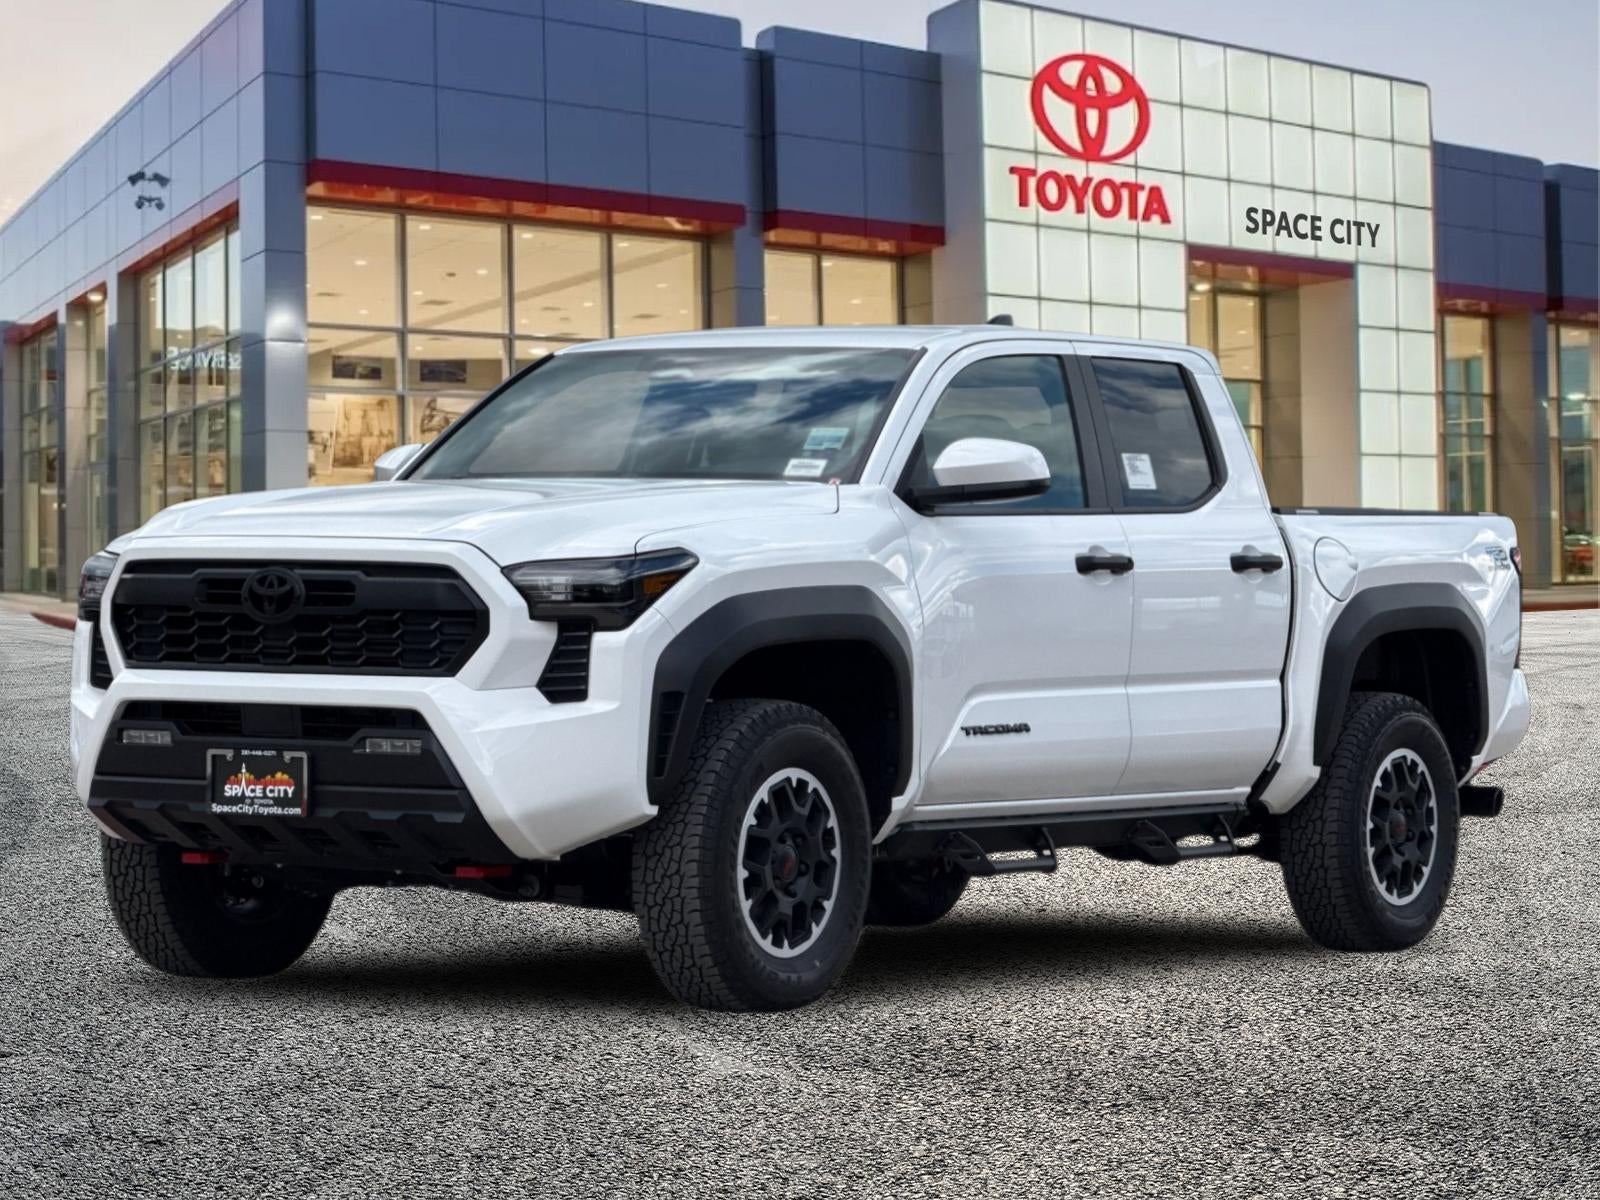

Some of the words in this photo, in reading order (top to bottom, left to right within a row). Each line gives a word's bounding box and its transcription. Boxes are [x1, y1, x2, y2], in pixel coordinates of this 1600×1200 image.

[1008, 165, 1171, 224] TOYOTA
[1245, 206, 1323, 242] SPACE
[1329, 218, 1381, 248] CITY
[960, 722, 1031, 736] TACOMA
[224, 784, 263, 797] SPACE
[265, 785, 295, 798] CITY
[211, 803, 301, 815] SpaceCityToyota.com
